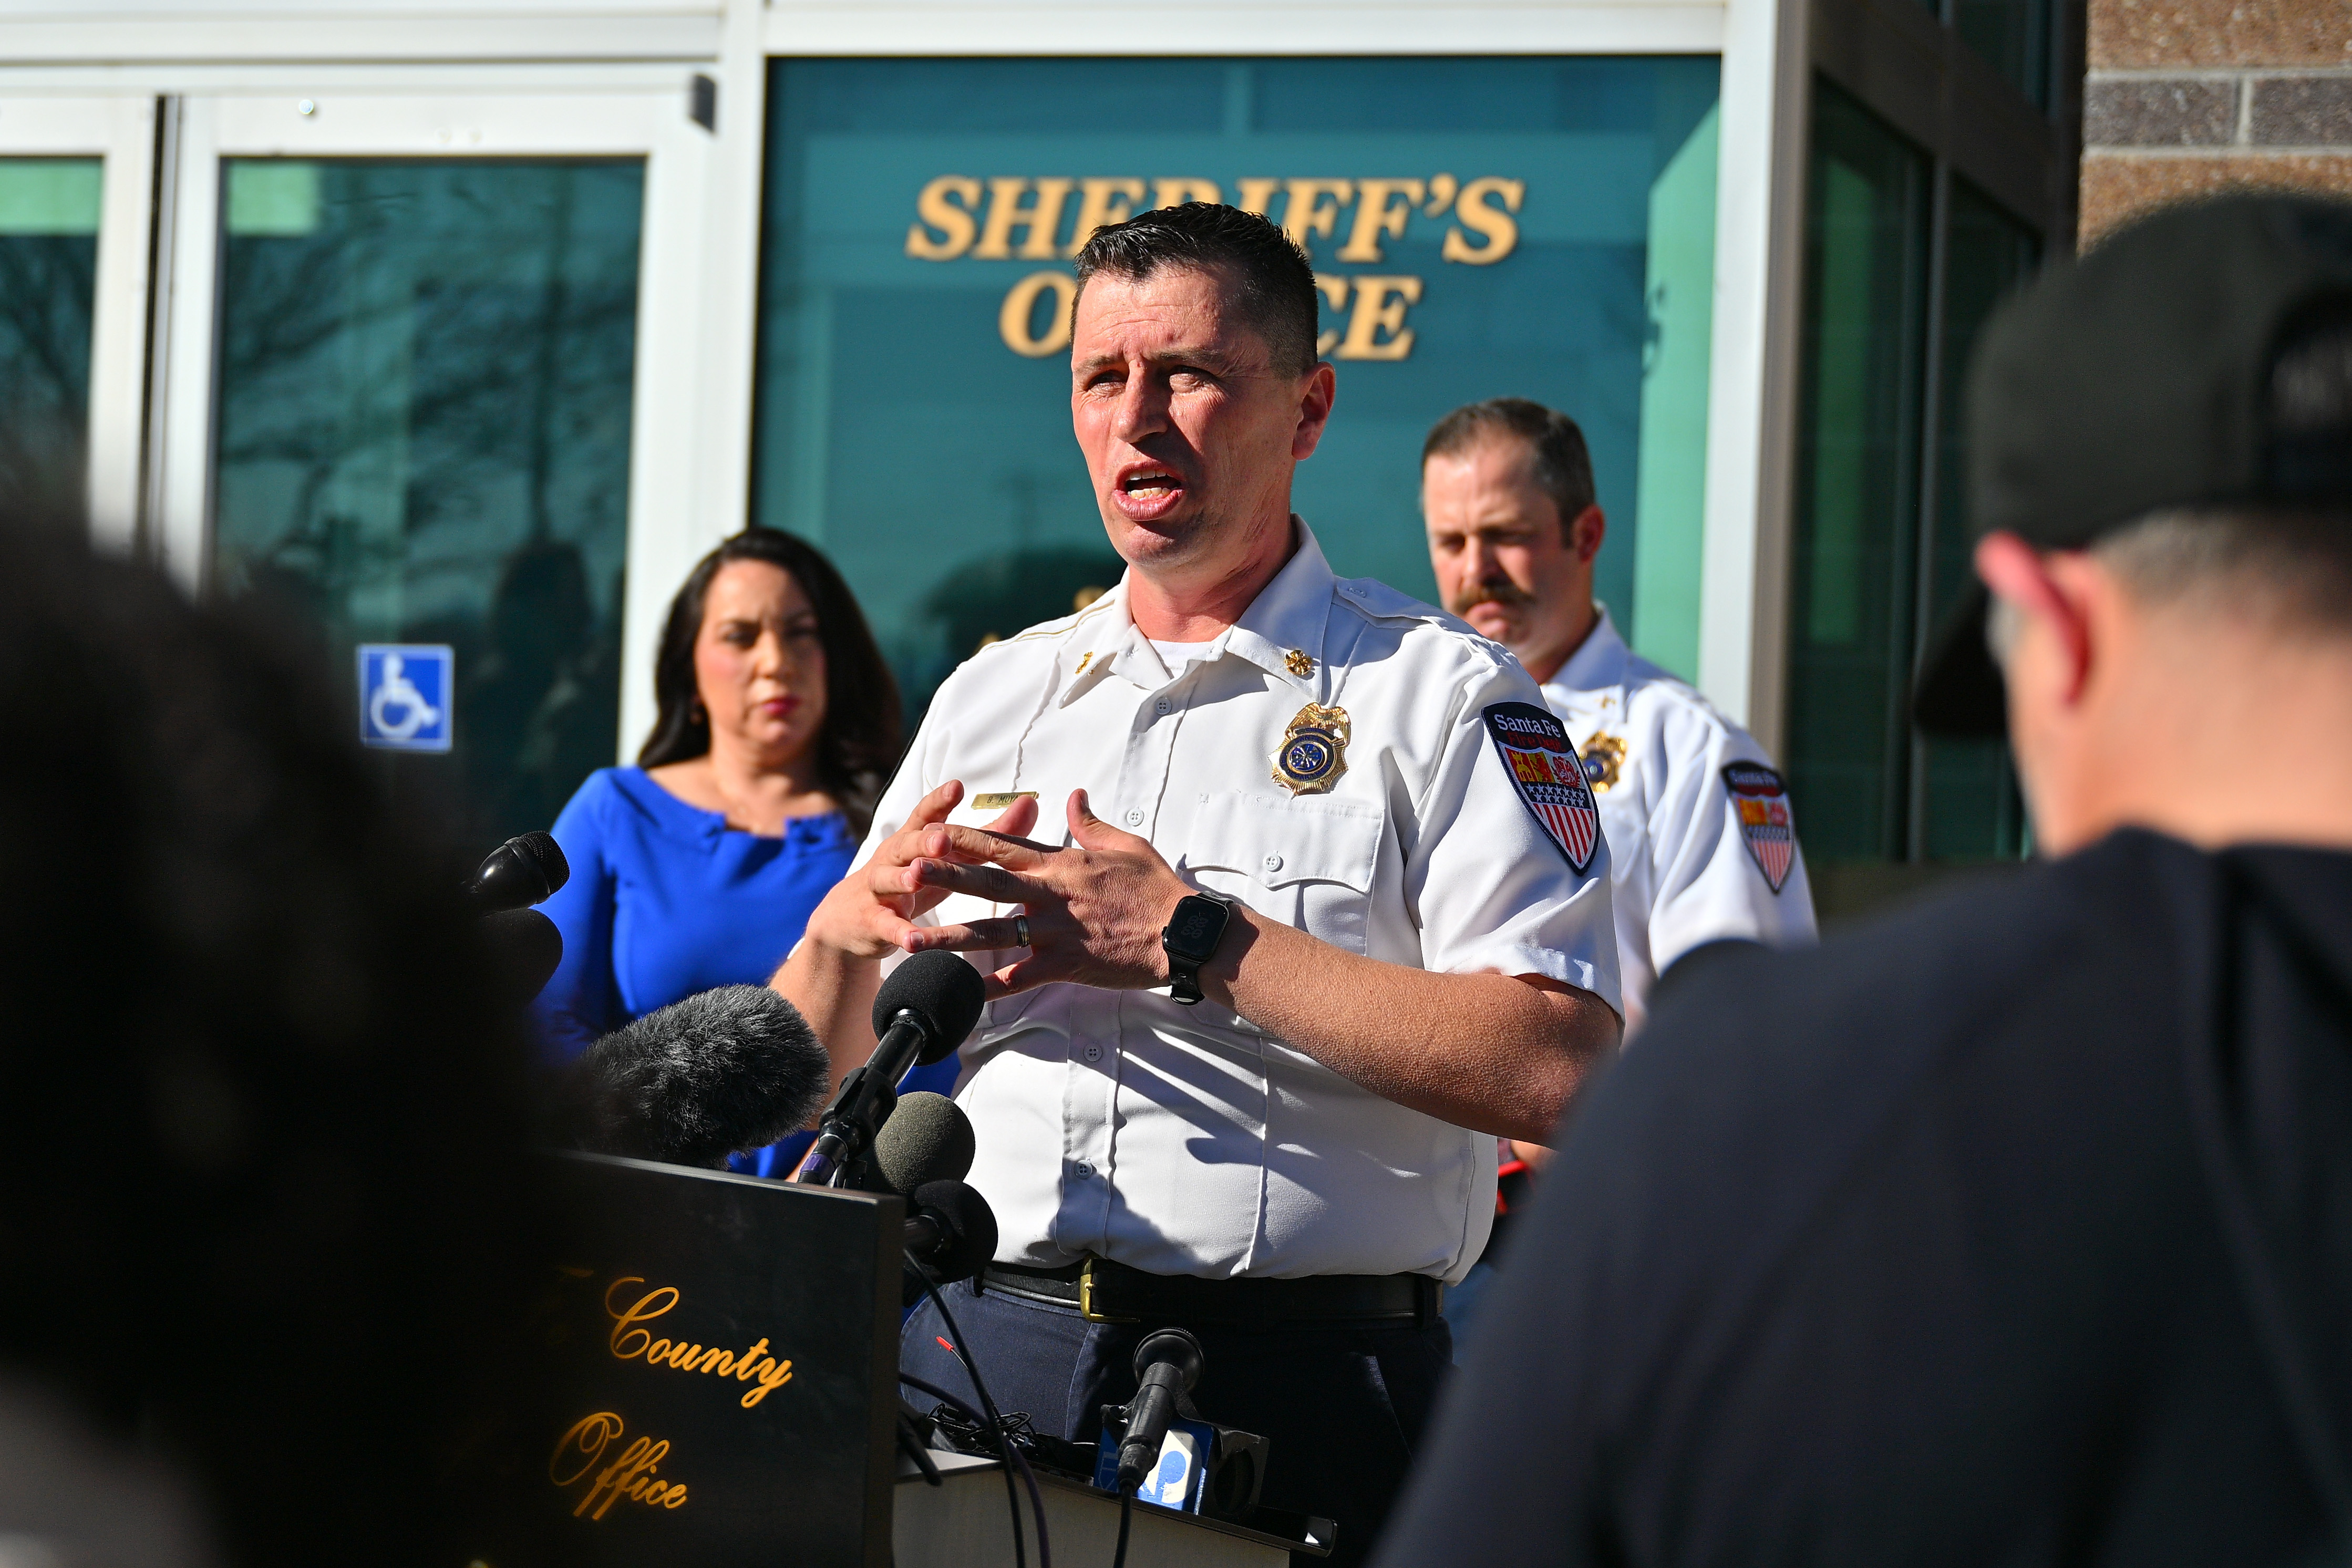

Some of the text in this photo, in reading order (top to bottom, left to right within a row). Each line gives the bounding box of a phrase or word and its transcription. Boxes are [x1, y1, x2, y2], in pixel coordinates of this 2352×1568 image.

[1494, 714, 1561, 738] Santa Fe
[1506, 731, 1536, 747] Fire
[987, 796, 994, 804] B.
[604, 1276, 793, 1409] County
[549, 1411, 688, 1521] Office
